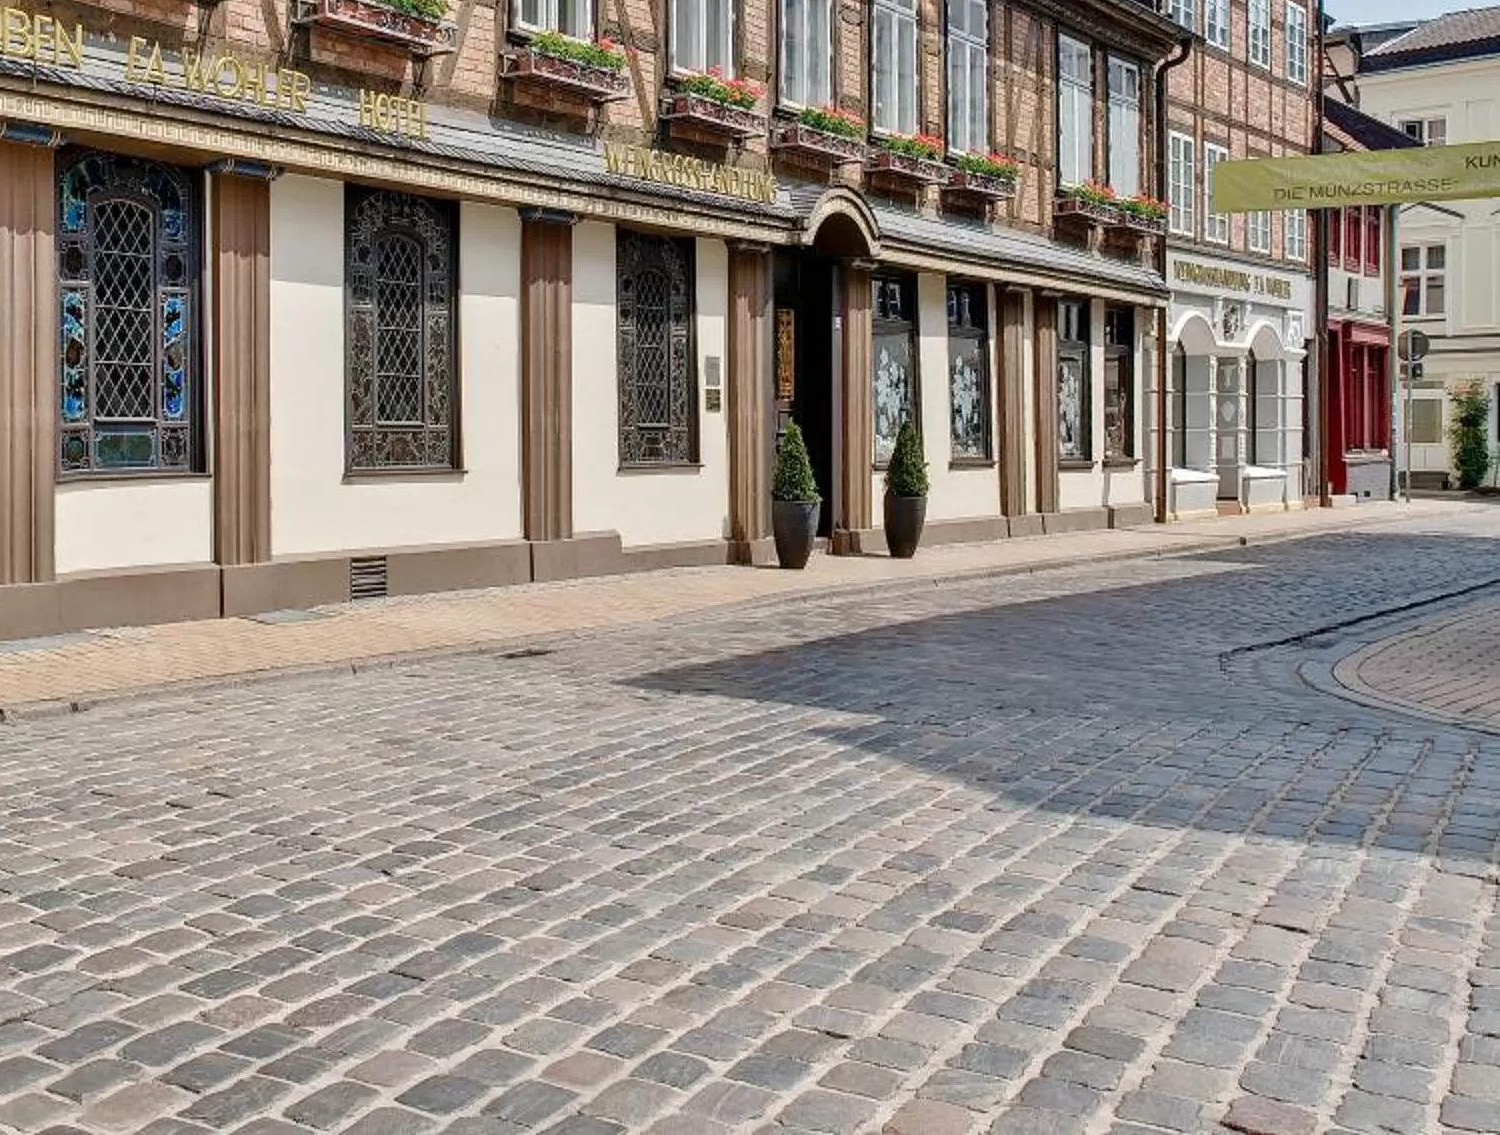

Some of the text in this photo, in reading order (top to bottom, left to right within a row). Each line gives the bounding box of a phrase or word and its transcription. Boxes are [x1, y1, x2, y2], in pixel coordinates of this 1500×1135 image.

[182, 41, 311, 114] WÖHLER
[360, 88, 428, 139] HOTEL
[1273, 186, 1305, 201] DIE
